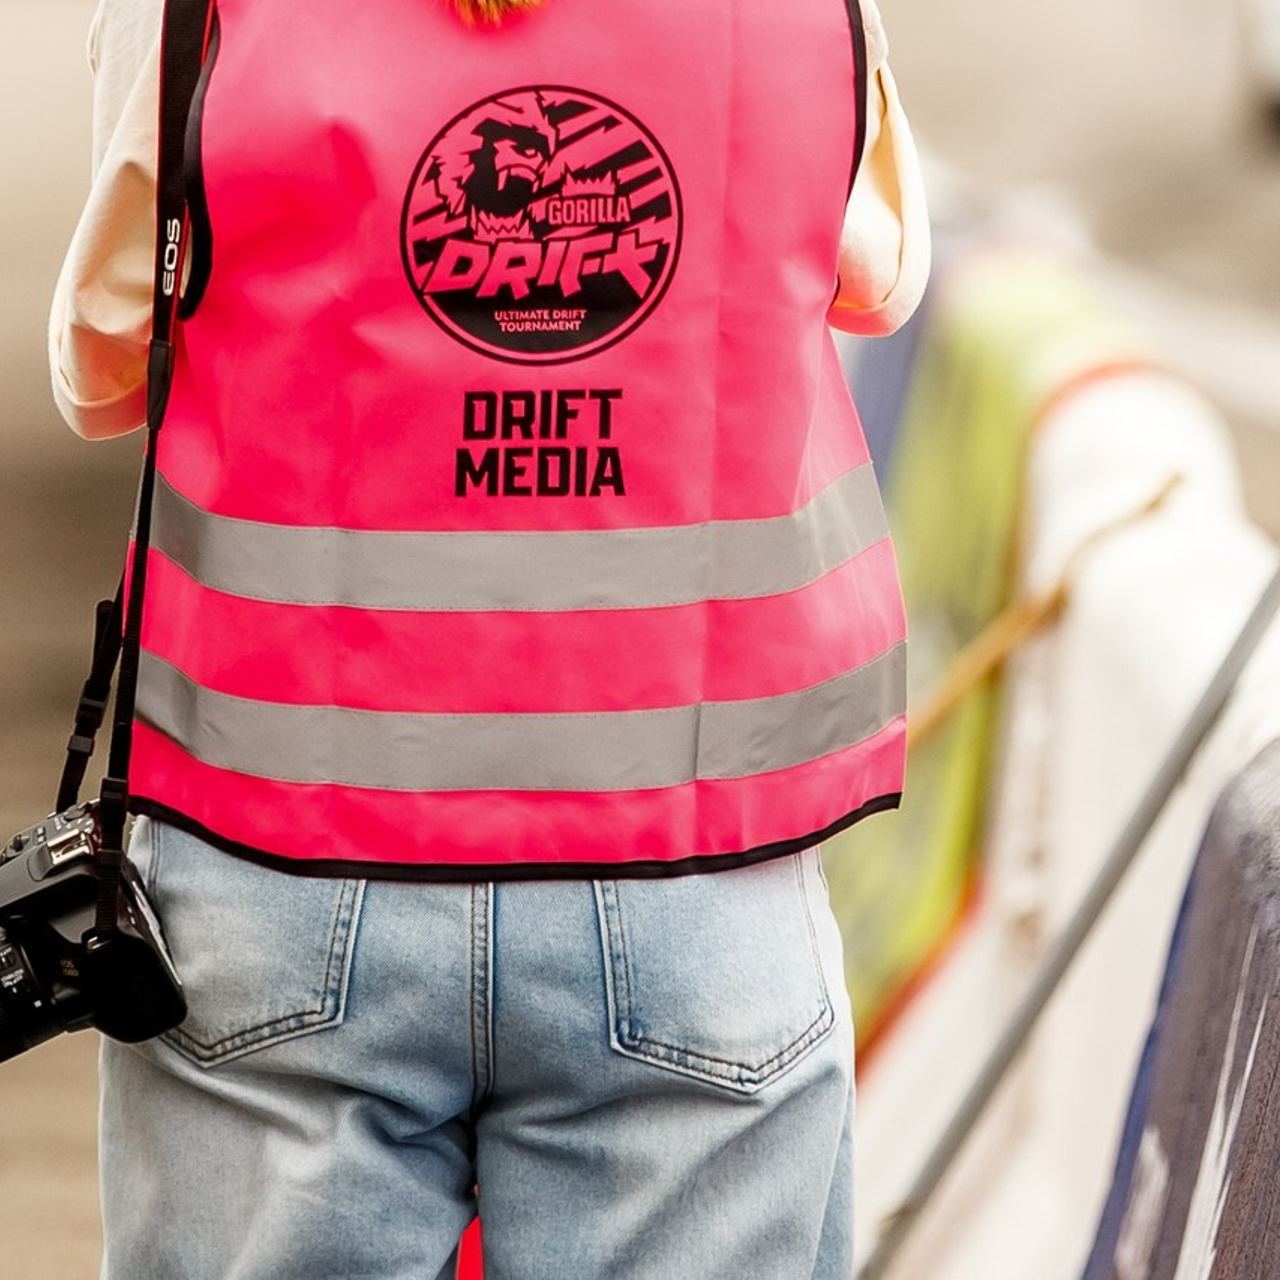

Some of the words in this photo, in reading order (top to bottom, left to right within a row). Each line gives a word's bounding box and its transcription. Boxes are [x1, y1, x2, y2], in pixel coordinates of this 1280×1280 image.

[548, 196, 631, 225] GORILLA
[162, 218, 181, 296] EOS
[423, 228, 660, 299] DRIFT
[494, 309, 551, 321] ULTIMATE
[553, 309, 587, 320] DRIFT
[499, 320, 581, 332] TOURNAMENT
[464, 389, 622, 440] DRIFT
[455, 446, 626, 498] MEDIA
